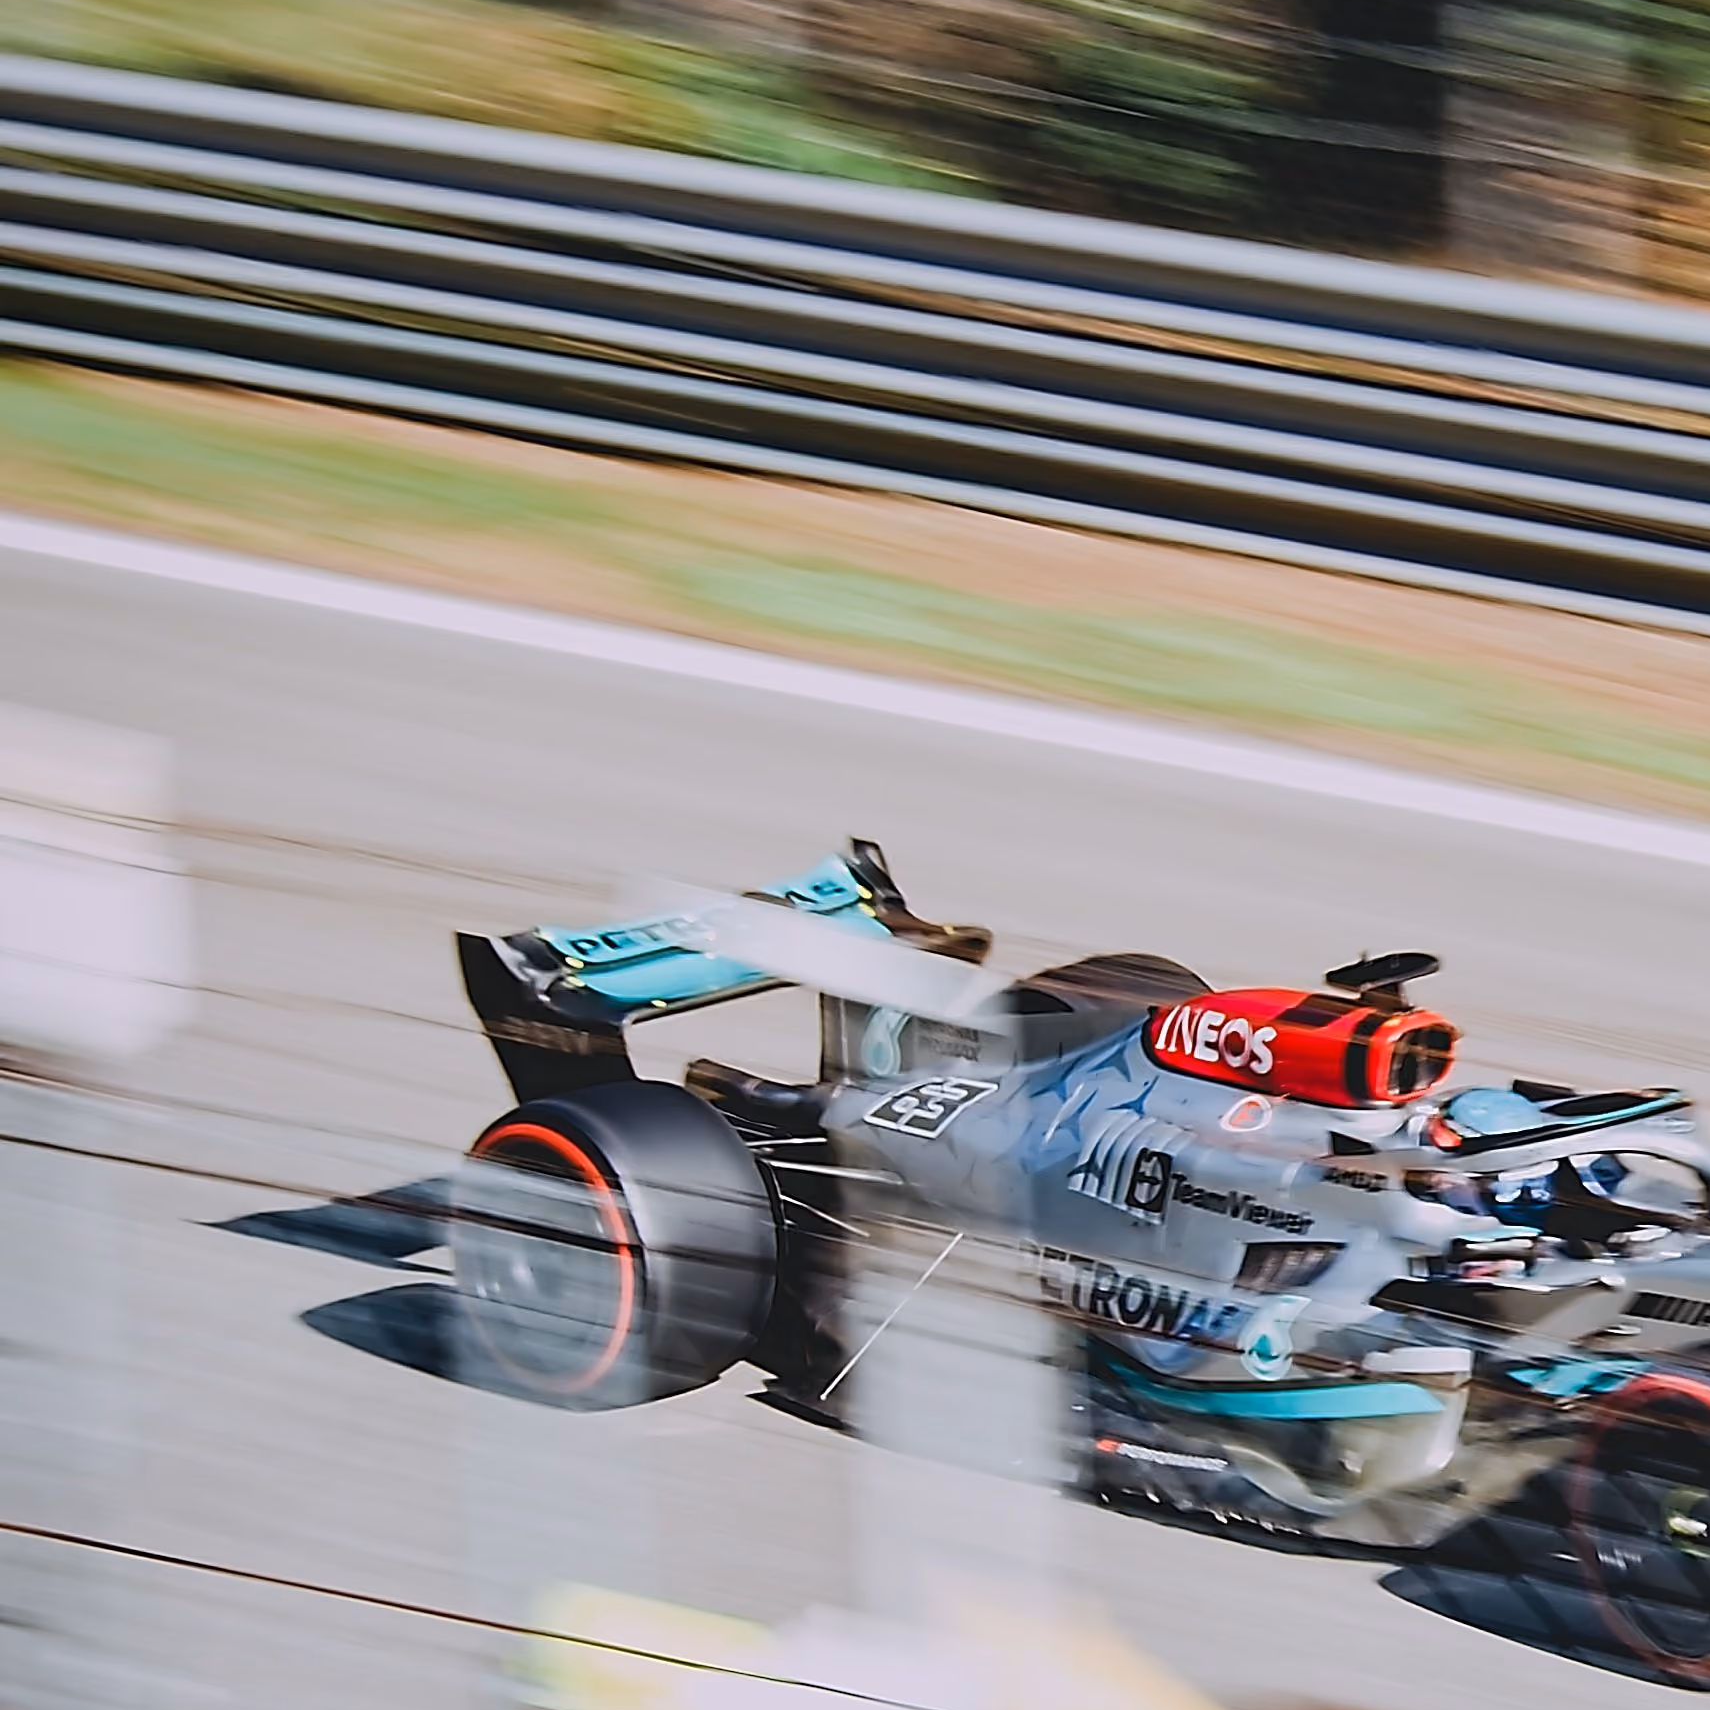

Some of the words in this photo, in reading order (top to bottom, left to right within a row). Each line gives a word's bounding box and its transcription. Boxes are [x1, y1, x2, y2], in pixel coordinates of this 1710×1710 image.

[1155, 1004, 1278, 1075] INEOS
[1171, 1171, 1315, 1235] TeamViewer
[1020, 1238, 1246, 1343] ETRONA
